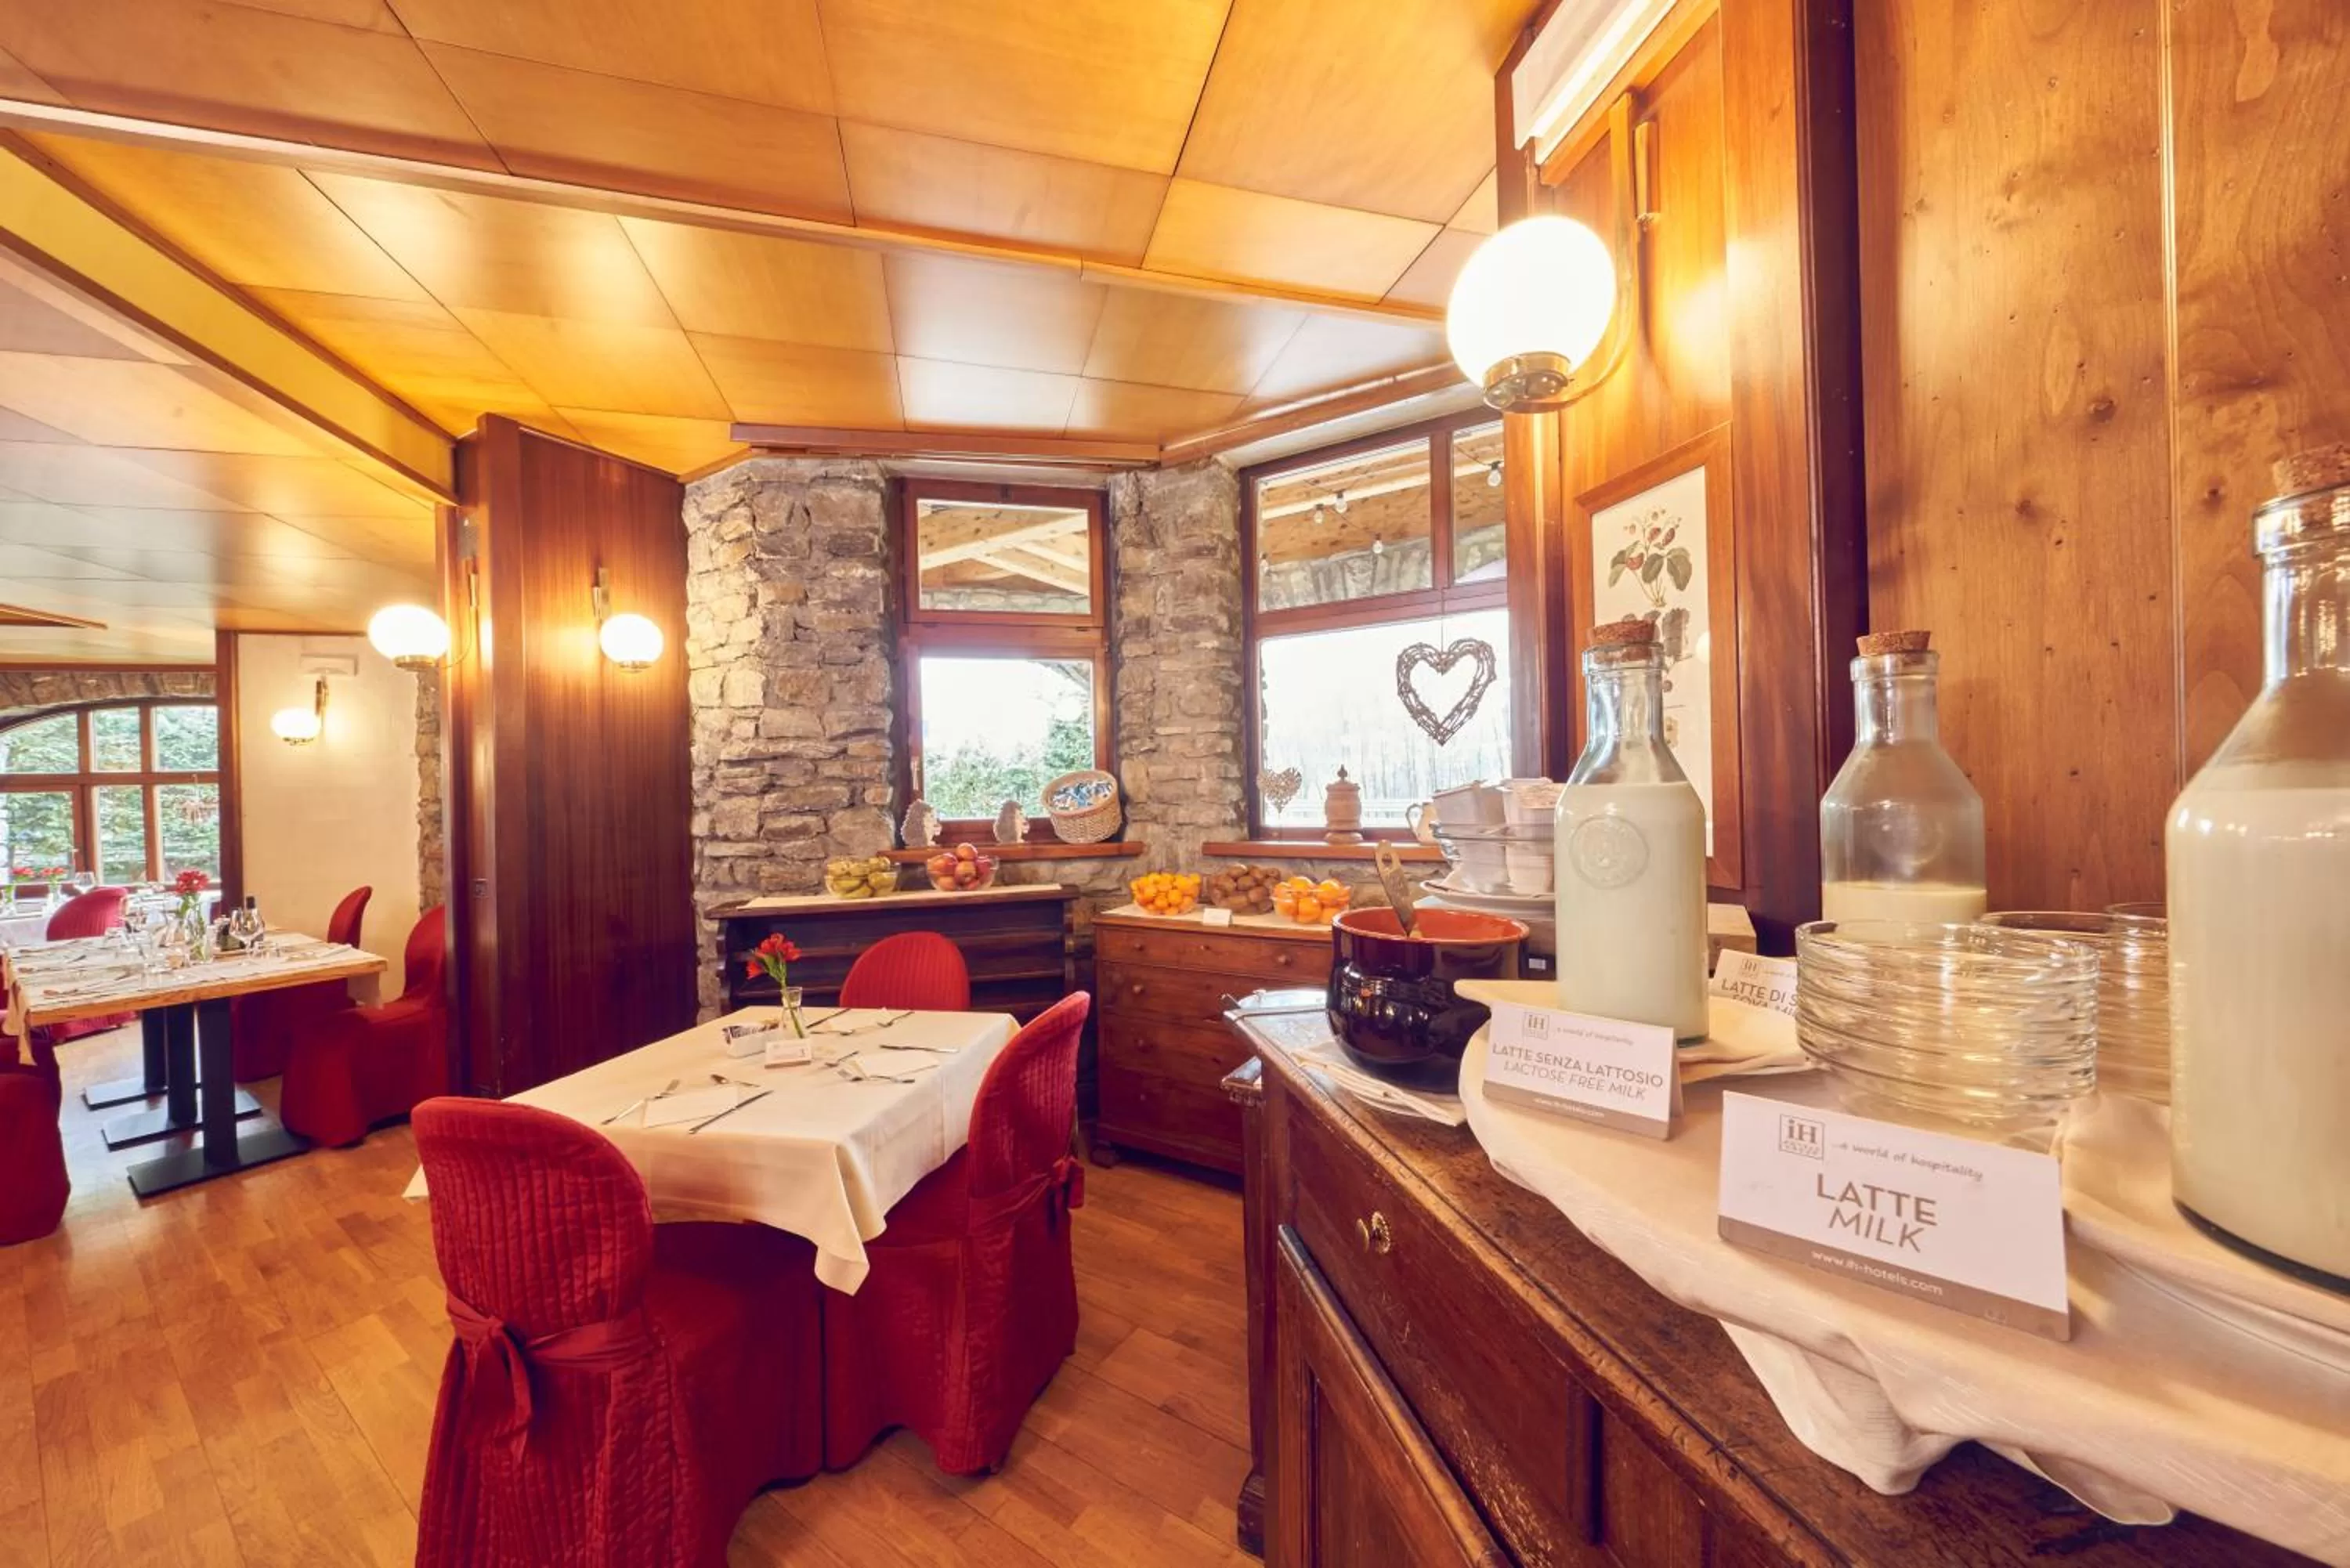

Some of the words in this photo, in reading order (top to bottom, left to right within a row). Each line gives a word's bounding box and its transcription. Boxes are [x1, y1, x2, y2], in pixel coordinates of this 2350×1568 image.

[1721, 977, 1767, 999] LATTE
[1770, 989, 1786, 1003] DI
[1492, 1042, 1534, 1061] LATTE
[1535, 1052, 1582, 1071] SENZA
[1585, 1062, 1664, 1088] LATTOSIO
[1503, 1060, 1567, 1084] LACTOSE
[1568, 1073, 1606, 1091] FREE
[1607, 1082, 1647, 1100] MILK
[1852, 1143, 1889, 1158] world
[1893, 1152, 1907, 1162] of
[1911, 1153, 1984, 1181] hospitality
[1817, 1172, 1938, 1226] LATTE
[1828, 1206, 1925, 1253] MILK
